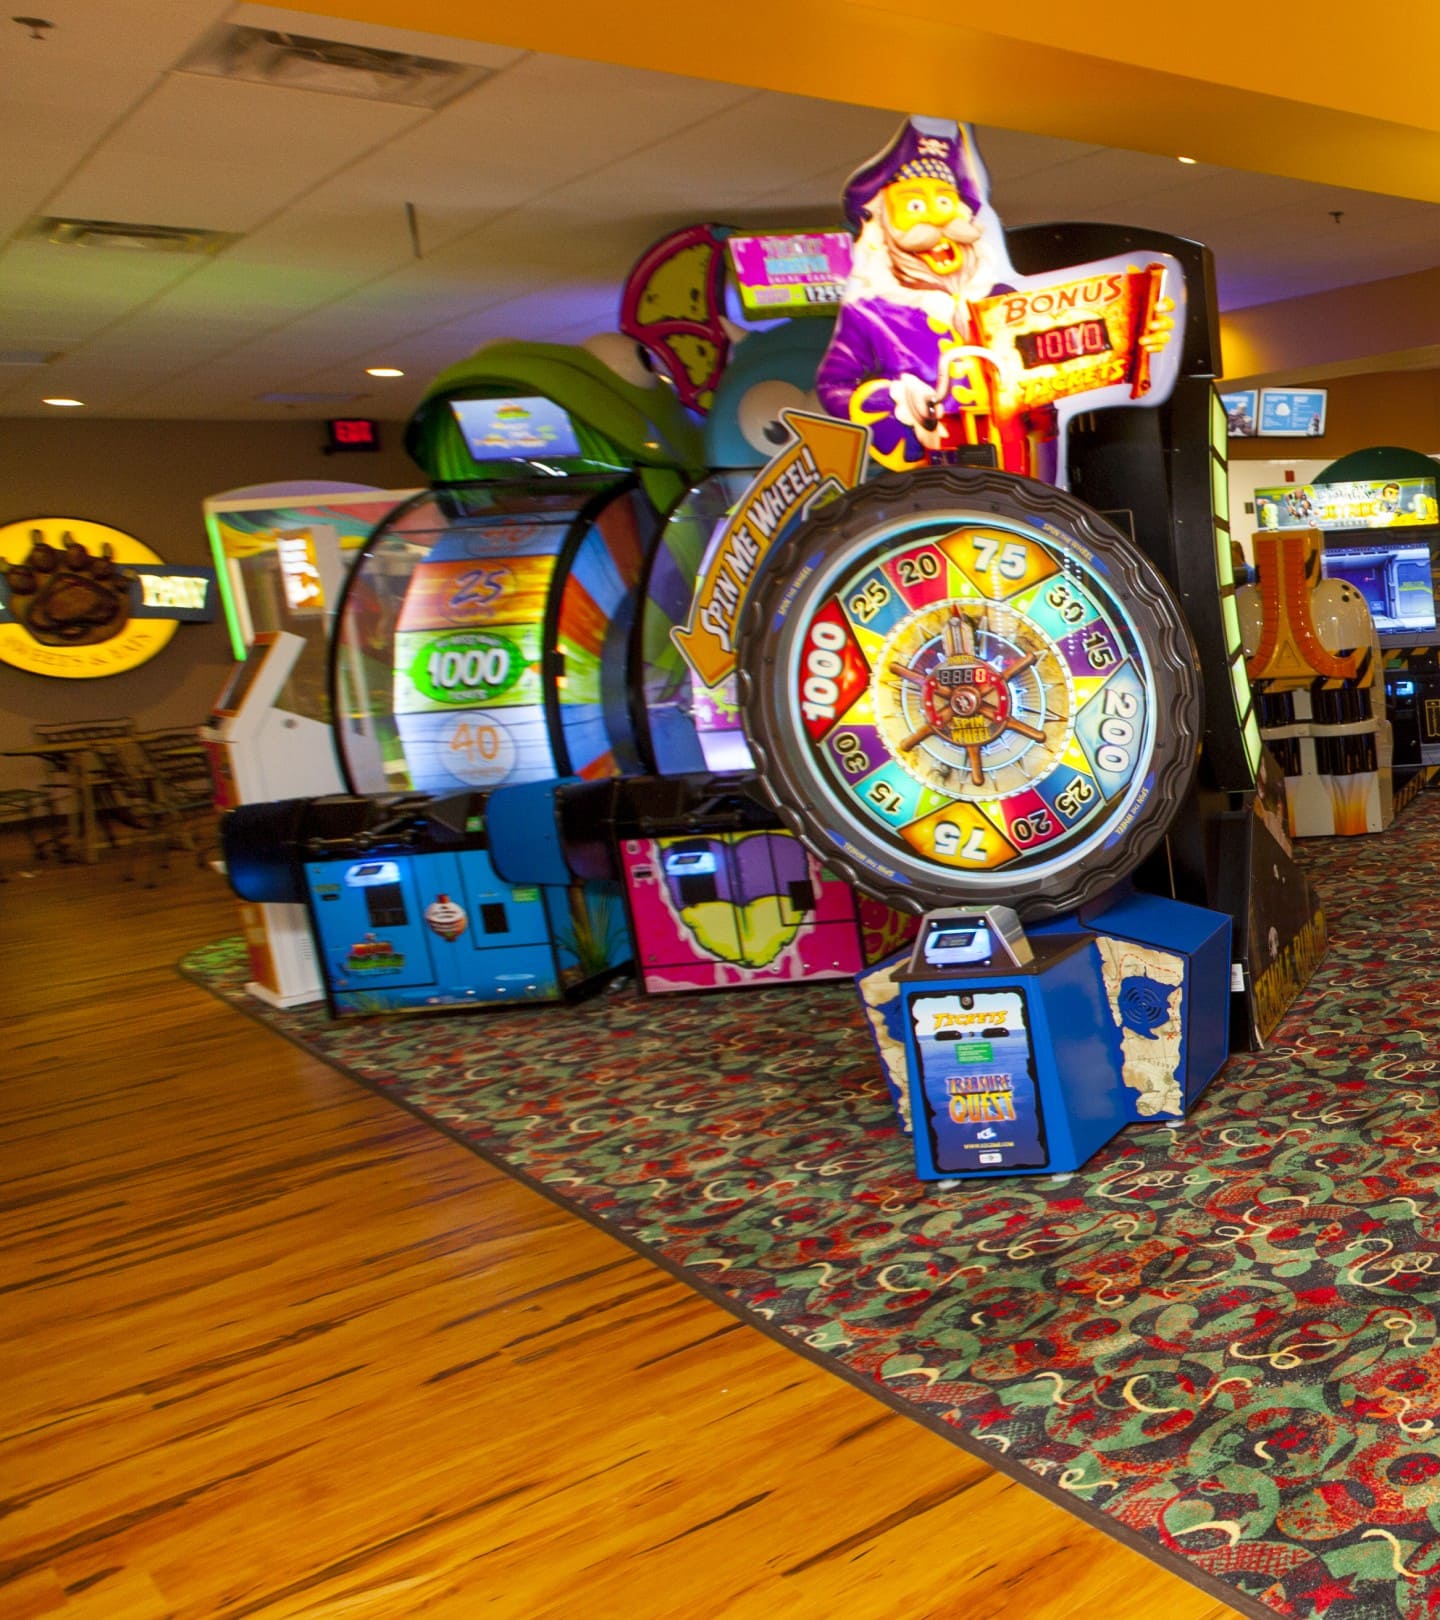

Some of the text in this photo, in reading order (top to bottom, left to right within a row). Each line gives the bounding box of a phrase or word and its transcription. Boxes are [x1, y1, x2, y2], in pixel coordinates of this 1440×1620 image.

[1003, 274, 1122, 324] BONUS
[1036, 323, 1102, 359] 1000
[1018, 357, 1127, 403] TICKETS
[700, 446, 821, 653] SPIN ME WHEEL!
[899, 553, 940, 586] 20
[972, 536, 1028, 580] 75
[450, 568, 505, 607] 25
[850, 578, 889, 624] 25
[1046, 584, 1085, 626] 30
[427, 647, 510, 689] 1000
[802, 621, 847, 722] 1000
[1083, 631, 1118, 671] 15
[450, 722, 498, 762] 40
[952, 715, 985, 728] SPIN
[1096, 688, 1138, 773] 200
[832, 731, 870, 774] 30
[868, 780, 905, 814] 15
[1055, 775, 1096, 819] 25
[933, 820, 989, 862] 75
[1012, 808, 1053, 842] 20
[932, 1010, 1008, 1030] TICKETS
[947, 1074, 1013, 1095] TREASURE
[949, 1090, 1017, 1124] QUEST
